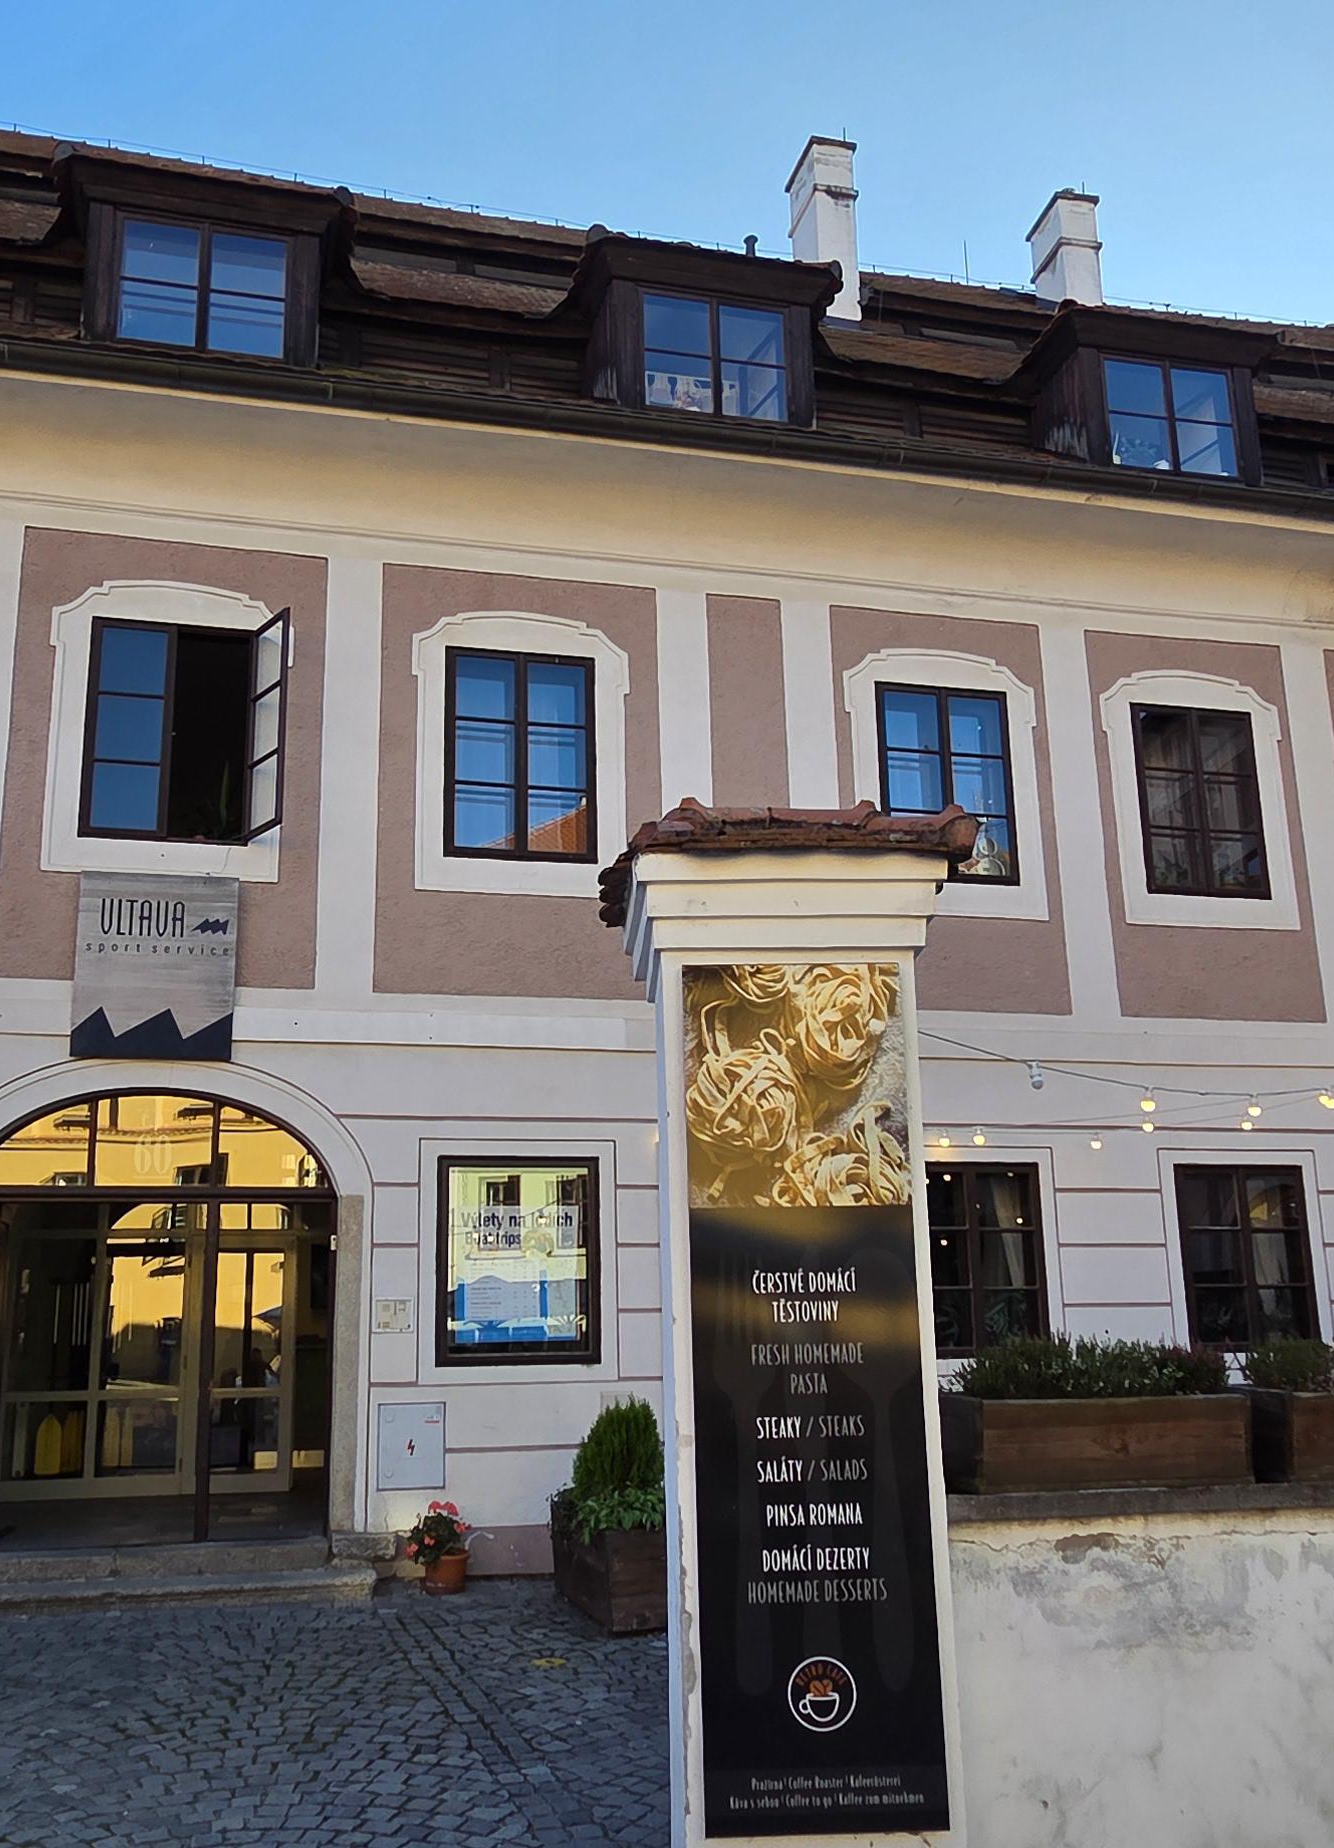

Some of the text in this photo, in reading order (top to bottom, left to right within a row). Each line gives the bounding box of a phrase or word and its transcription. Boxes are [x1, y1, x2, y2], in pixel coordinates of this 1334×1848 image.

[100, 898, 185, 938] VLTAVA
[85, 942, 229, 957] sport service
[752, 1266, 857, 1294] ČERSTVÉ DOMÁCÍ
[771, 1298, 839, 1323] TĚSTOVINY
[751, 1342, 864, 1366] FRESH HOMEMADE
[790, 1372, 828, 1395] PASTA
[756, 1416, 802, 1440] STEAKY
[818, 1414, 866, 1438] STEAKS
[756, 1455, 803, 1483] SALÁTY
[819, 1458, 869, 1482] SALADS
[766, 1502, 864, 1528] PINSA ROMANA
[762, 1544, 869, 1573] DOMÁCÍ DEZERTY
[747, 1577, 888, 1605] HOMEMADE DESSERTS
